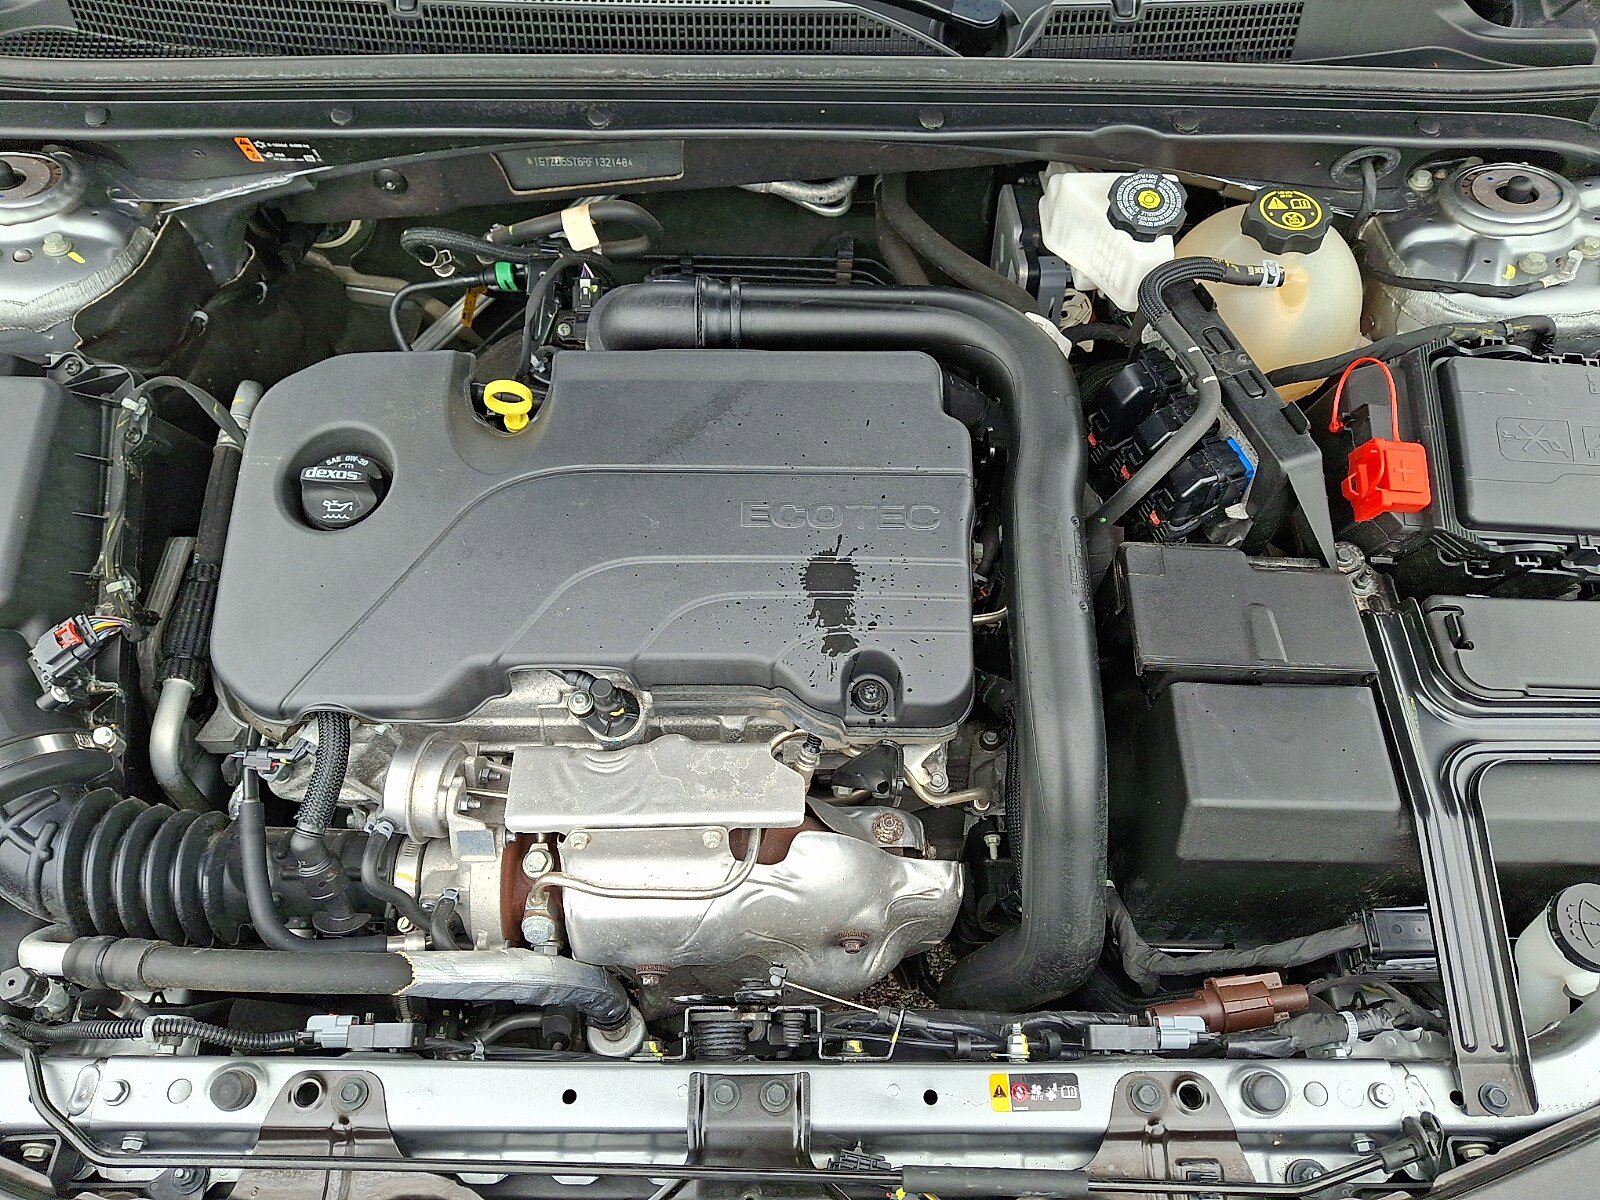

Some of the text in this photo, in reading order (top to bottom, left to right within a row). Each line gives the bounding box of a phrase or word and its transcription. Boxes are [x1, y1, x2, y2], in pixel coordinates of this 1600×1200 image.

[325, 455, 369, 466] SAE 0W-20
[304, 466, 362, 480] dexos
[740, 501, 940, 531] ECOTEC
